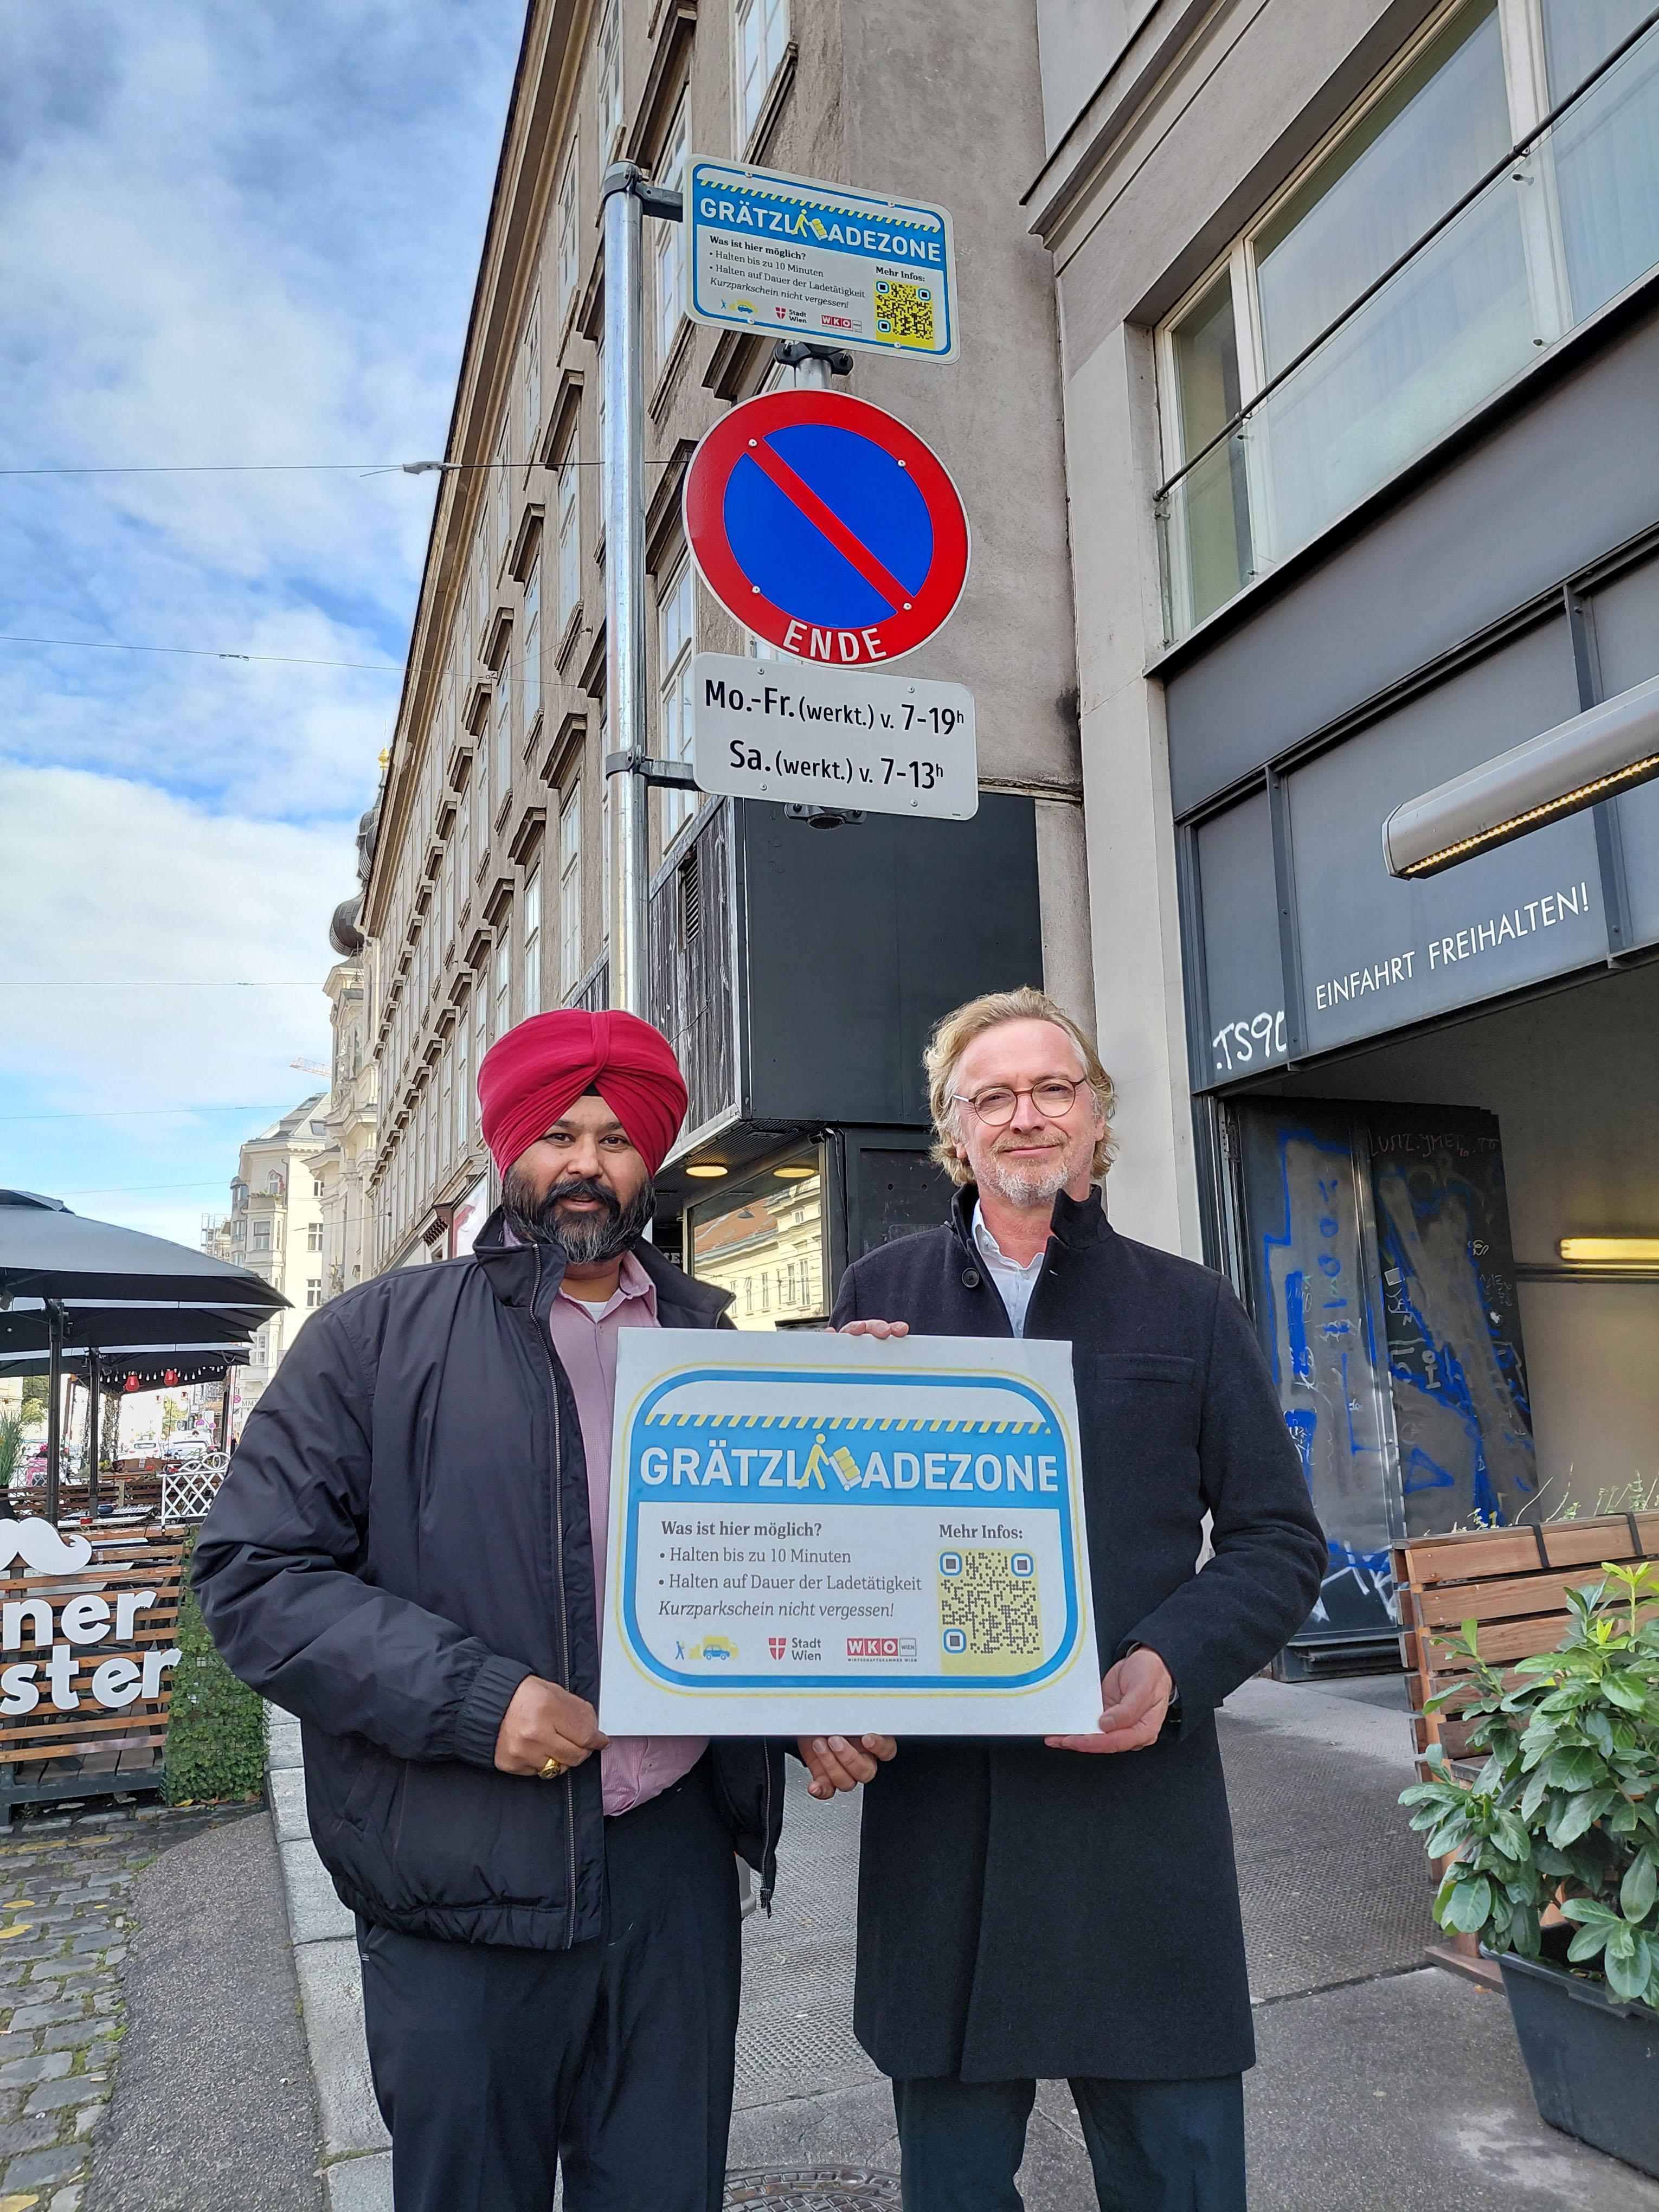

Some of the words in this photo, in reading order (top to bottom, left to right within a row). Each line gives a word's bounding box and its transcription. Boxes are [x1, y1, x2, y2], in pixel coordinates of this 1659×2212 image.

[710, 235, 729, 246] Was
[731, 239, 743, 249] ist
[745, 241, 763, 253] hier
[766, 247, 806, 260] möglich?
[715, 250, 745, 262] Halten
[747, 256, 760, 266] bis
[762, 260, 773, 268] zu
[776, 261, 785, 270] 10
[788, 263, 824, 277] Minuten
[715, 264, 745, 276] Halten
[748, 271, 762, 280] auf
[764, 274, 790, 285] Dauer
[793, 278, 807, 287] der
[809, 281, 865, 298] Ladetätigkeit
[876, 266, 898, 277] Mehr
[901, 271, 925, 282] Infos:
[710, 277, 779, 297] Kurzparkschein
[781, 290, 802, 301] nicht
[805, 295, 848, 308] vergessen!
[789, 309, 807, 317] Stadt
[789, 316, 807, 324] Wien
[822, 316, 850, 327] WKO
[783, 620, 887, 662] ENDE
[880, 711, 894, 729] v.
[859, 767, 873, 784] v.
[1315, 950, 1416, 1011] EINFAHRT
[1427, 882, 1590, 970] FREIHALTEN!
[661, 1520, 693, 1535] Was
[696, 1521, 716, 1535] ist
[719, 1521, 750, 1536] hier
[754, 1521, 822, 1540] möglich?
[939, 1523, 978, 1539] Mehr
[981, 1523, 1024, 1540] Infos:
[670, 1546, 719, 1562] Halten
[723, 1547, 744, 1562] bis
[748, 1552, 766, 1562] zu
[771, 1548, 787, 1562] 10
[790, 1548, 851, 1563] Minuten
[669, 1573, 718, 1589] Halten
[723, 1573, 748, 1589] auf
[750, 1574, 795, 1589] Dauer
[799, 1574, 823, 1590] der
[826, 1574, 922, 1594] Ladetätigkeit
[658, 1600, 774, 1619] Kurzparkschein
[779, 1601, 816, 1617] nicht
[819, 1603, 894, 1621] vergessen!
[792, 1637, 821, 1649] Stadt
[848, 1640, 896, 1654] WKO
[792, 1650, 822, 1661] Wien
